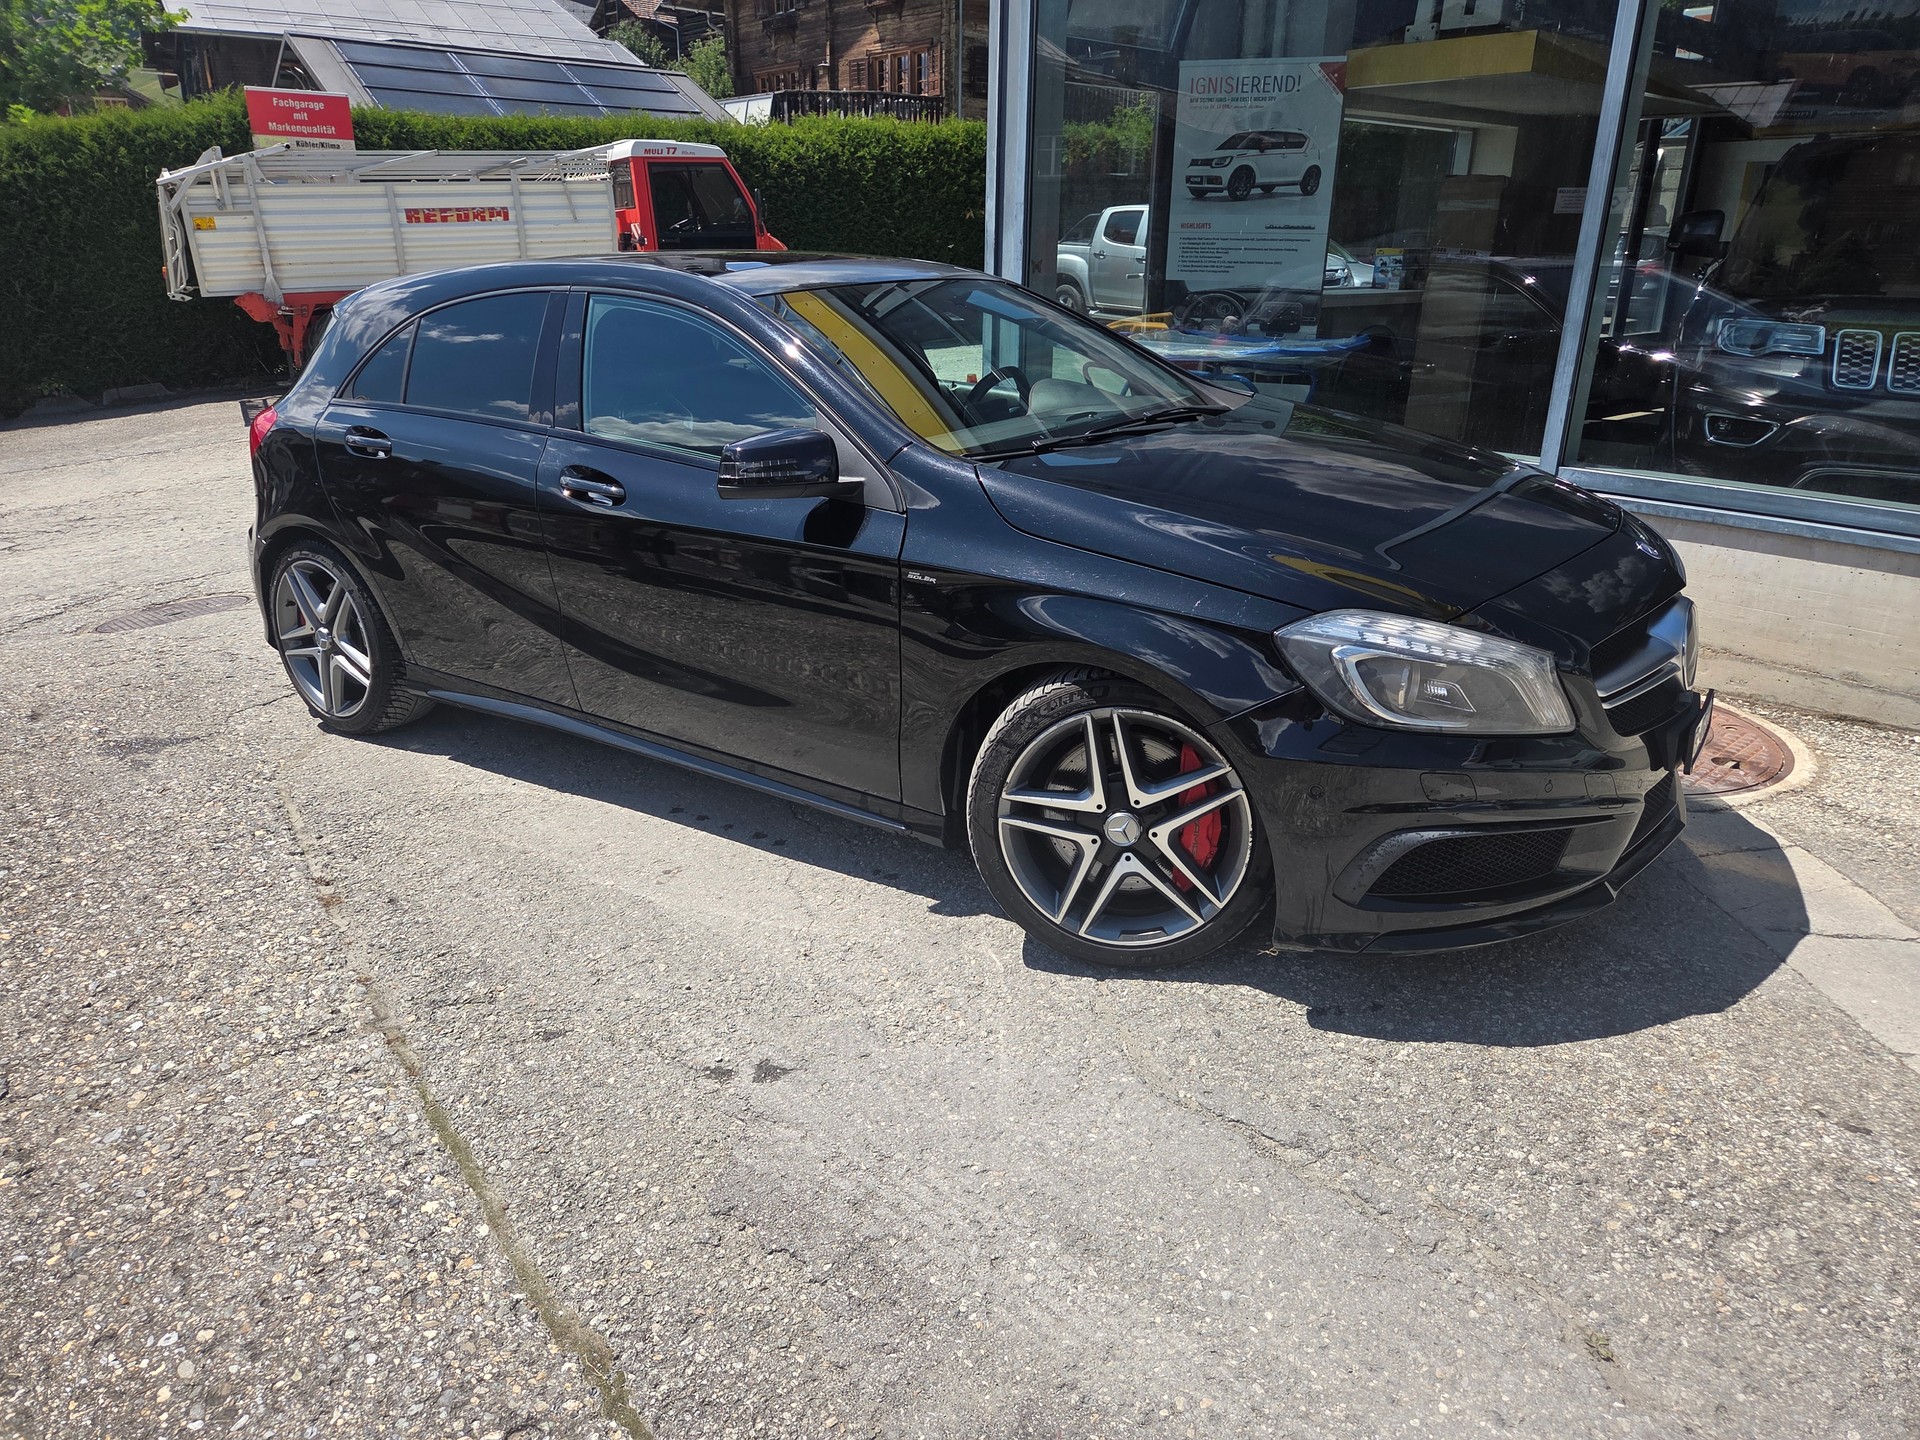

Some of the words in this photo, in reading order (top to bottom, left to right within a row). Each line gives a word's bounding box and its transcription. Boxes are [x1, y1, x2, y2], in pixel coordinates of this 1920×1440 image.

[1190, 75, 1302, 95] IGNISIEREND!
[272, 97, 325, 111] Fachgarage
[293, 111, 308, 120] mit
[268, 121, 336, 135] Markenqualität
[295, 140, 341, 150] Kühler/Klima
[666, 146, 678, 155] T7
[1180, 222, 1212, 230] HIGHLIGHTS
